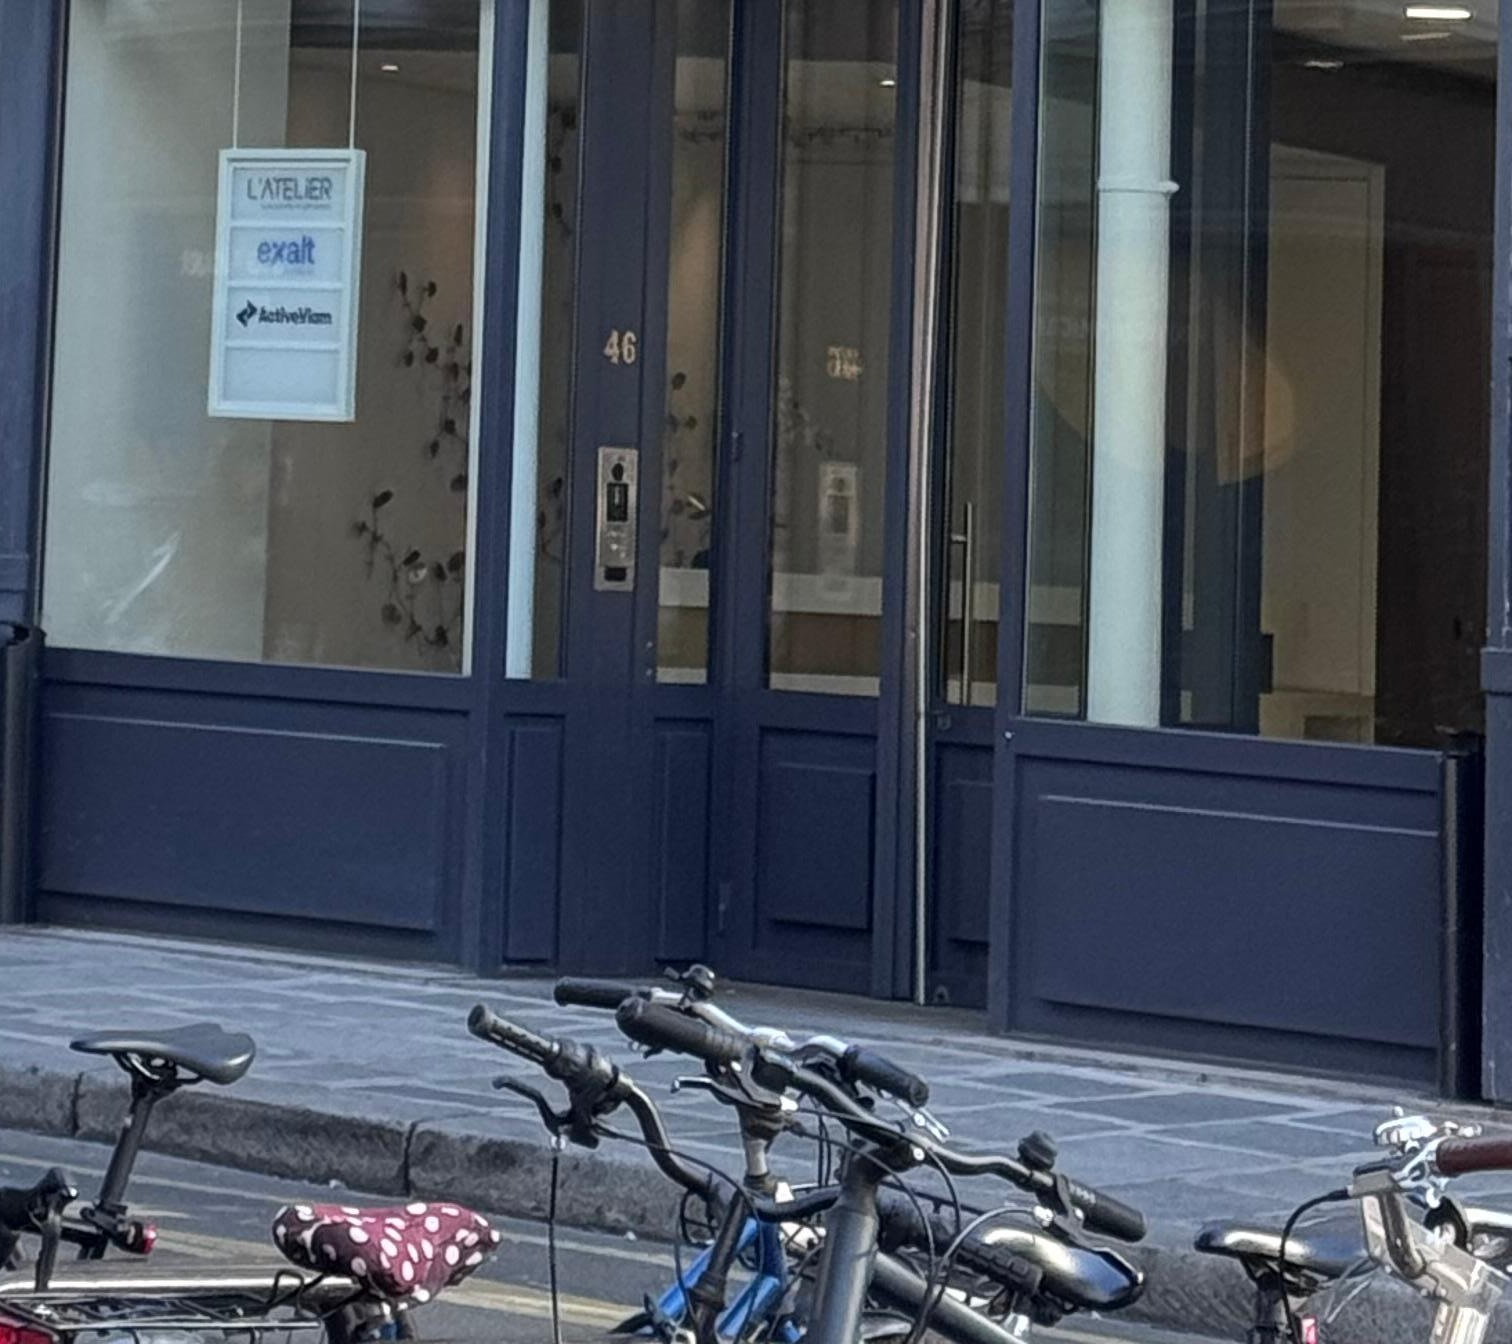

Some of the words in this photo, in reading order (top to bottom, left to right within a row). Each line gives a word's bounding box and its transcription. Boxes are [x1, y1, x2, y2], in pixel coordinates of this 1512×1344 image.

[256, 234, 316, 267] exalt
[258, 305, 333, 325] ActiveViam
[603, 329, 637, 364] 46
